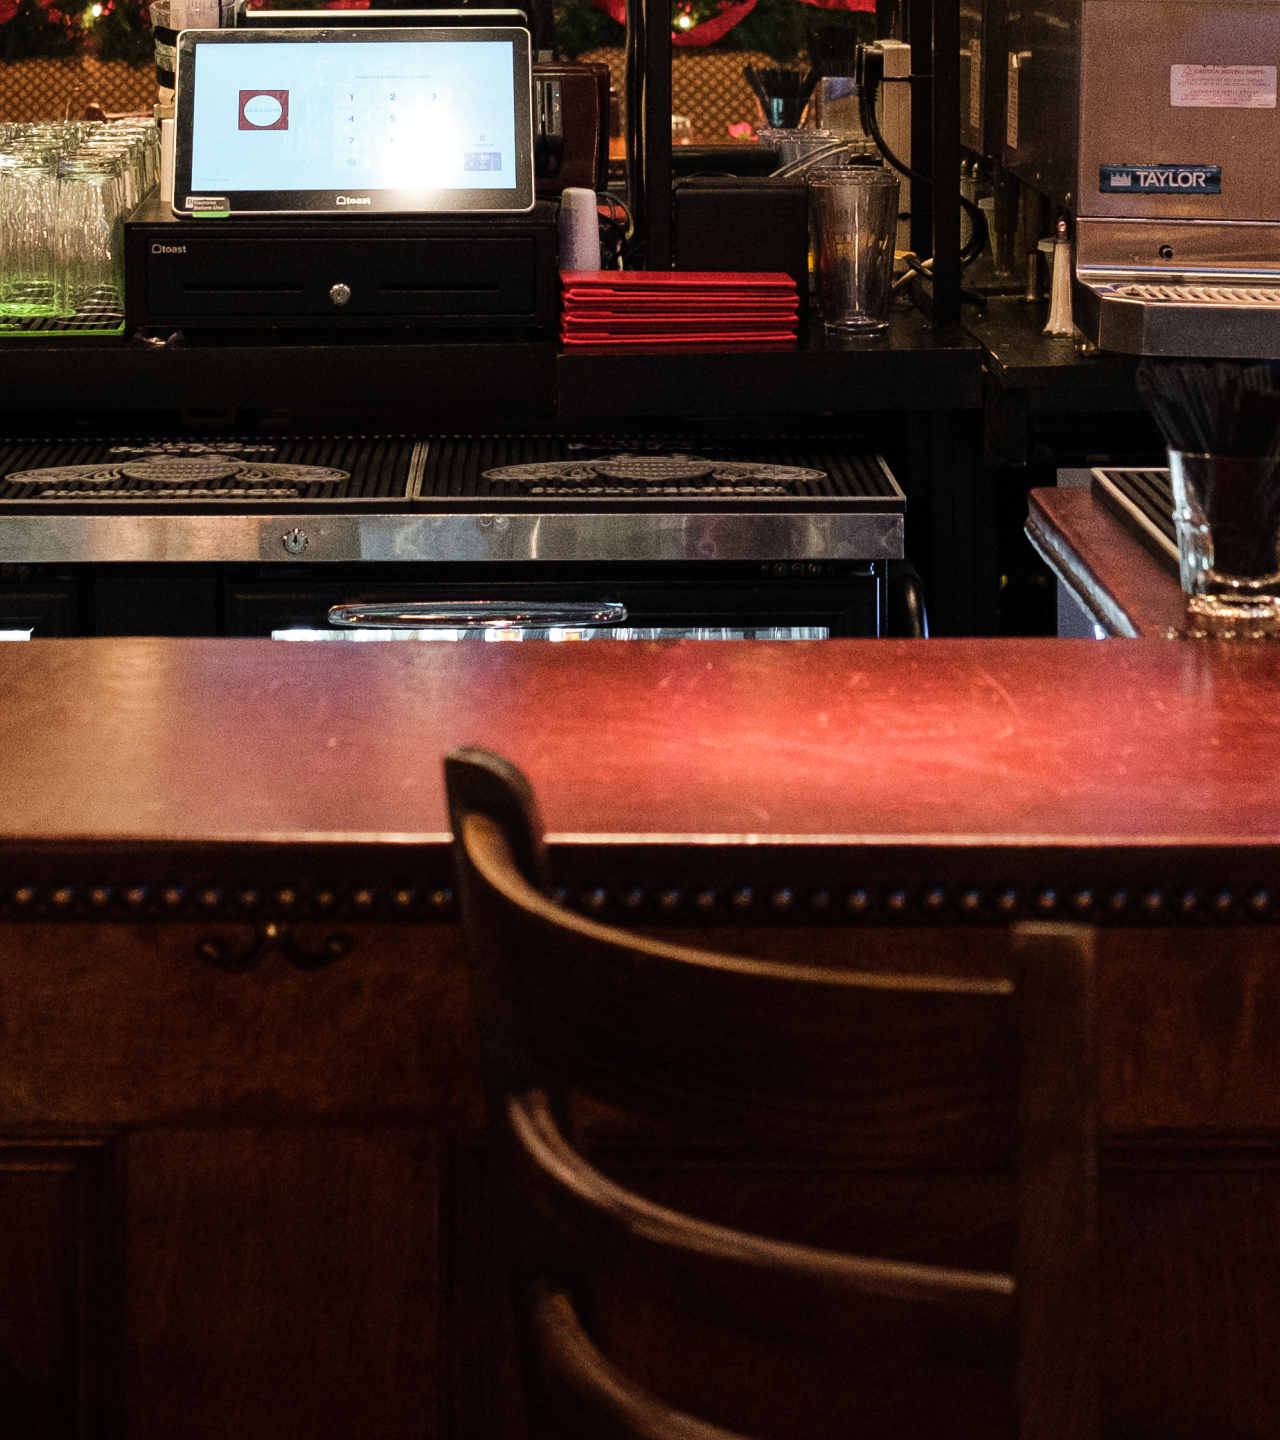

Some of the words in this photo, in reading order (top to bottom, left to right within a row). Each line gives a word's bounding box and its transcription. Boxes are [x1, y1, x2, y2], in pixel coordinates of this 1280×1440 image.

[1136, 171, 1206, 188] TAYLOR
[345, 196, 372, 206] toast
[161, 244, 188, 254] toast
